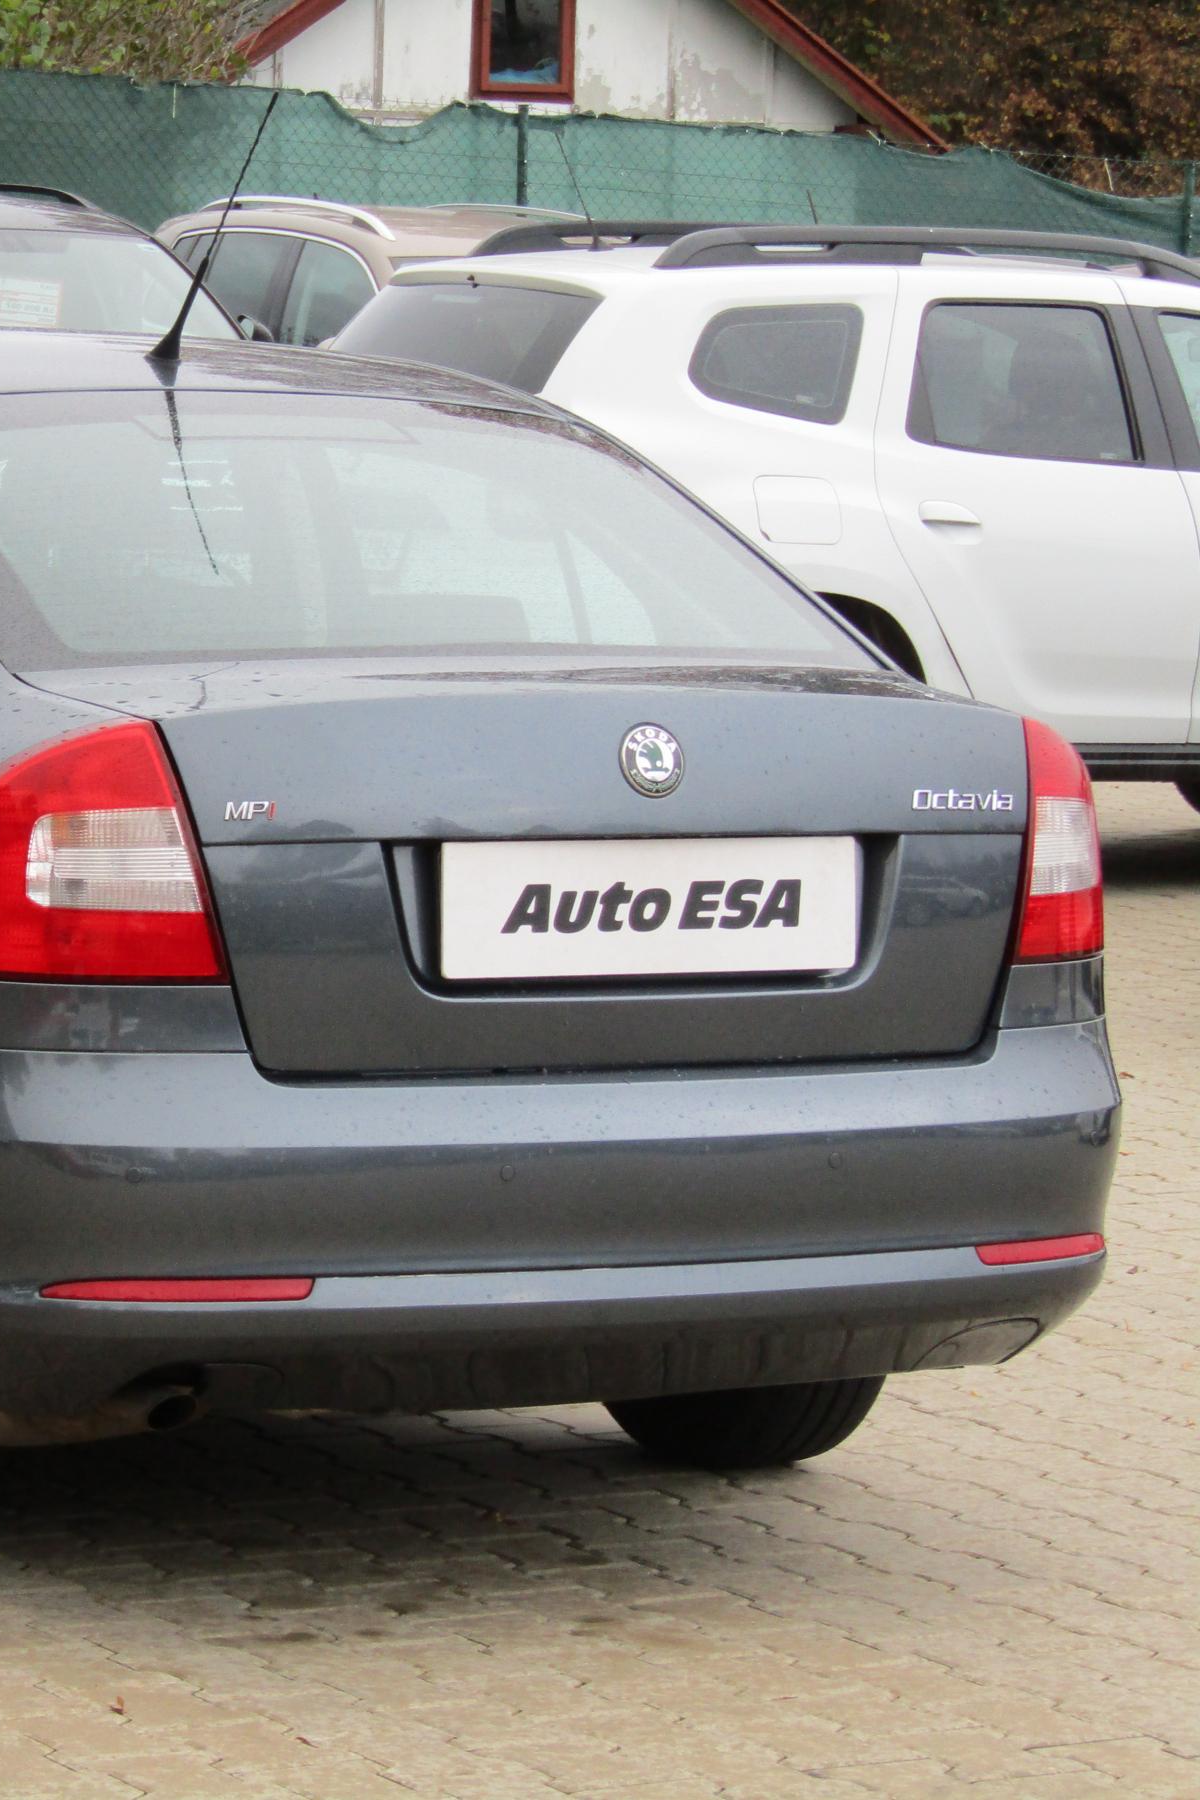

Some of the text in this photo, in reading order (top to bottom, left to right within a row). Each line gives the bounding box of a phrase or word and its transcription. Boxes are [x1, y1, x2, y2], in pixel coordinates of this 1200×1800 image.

[912, 788, 1014, 811] Octavia
[500, 878, 801, 934] Auto ESA
